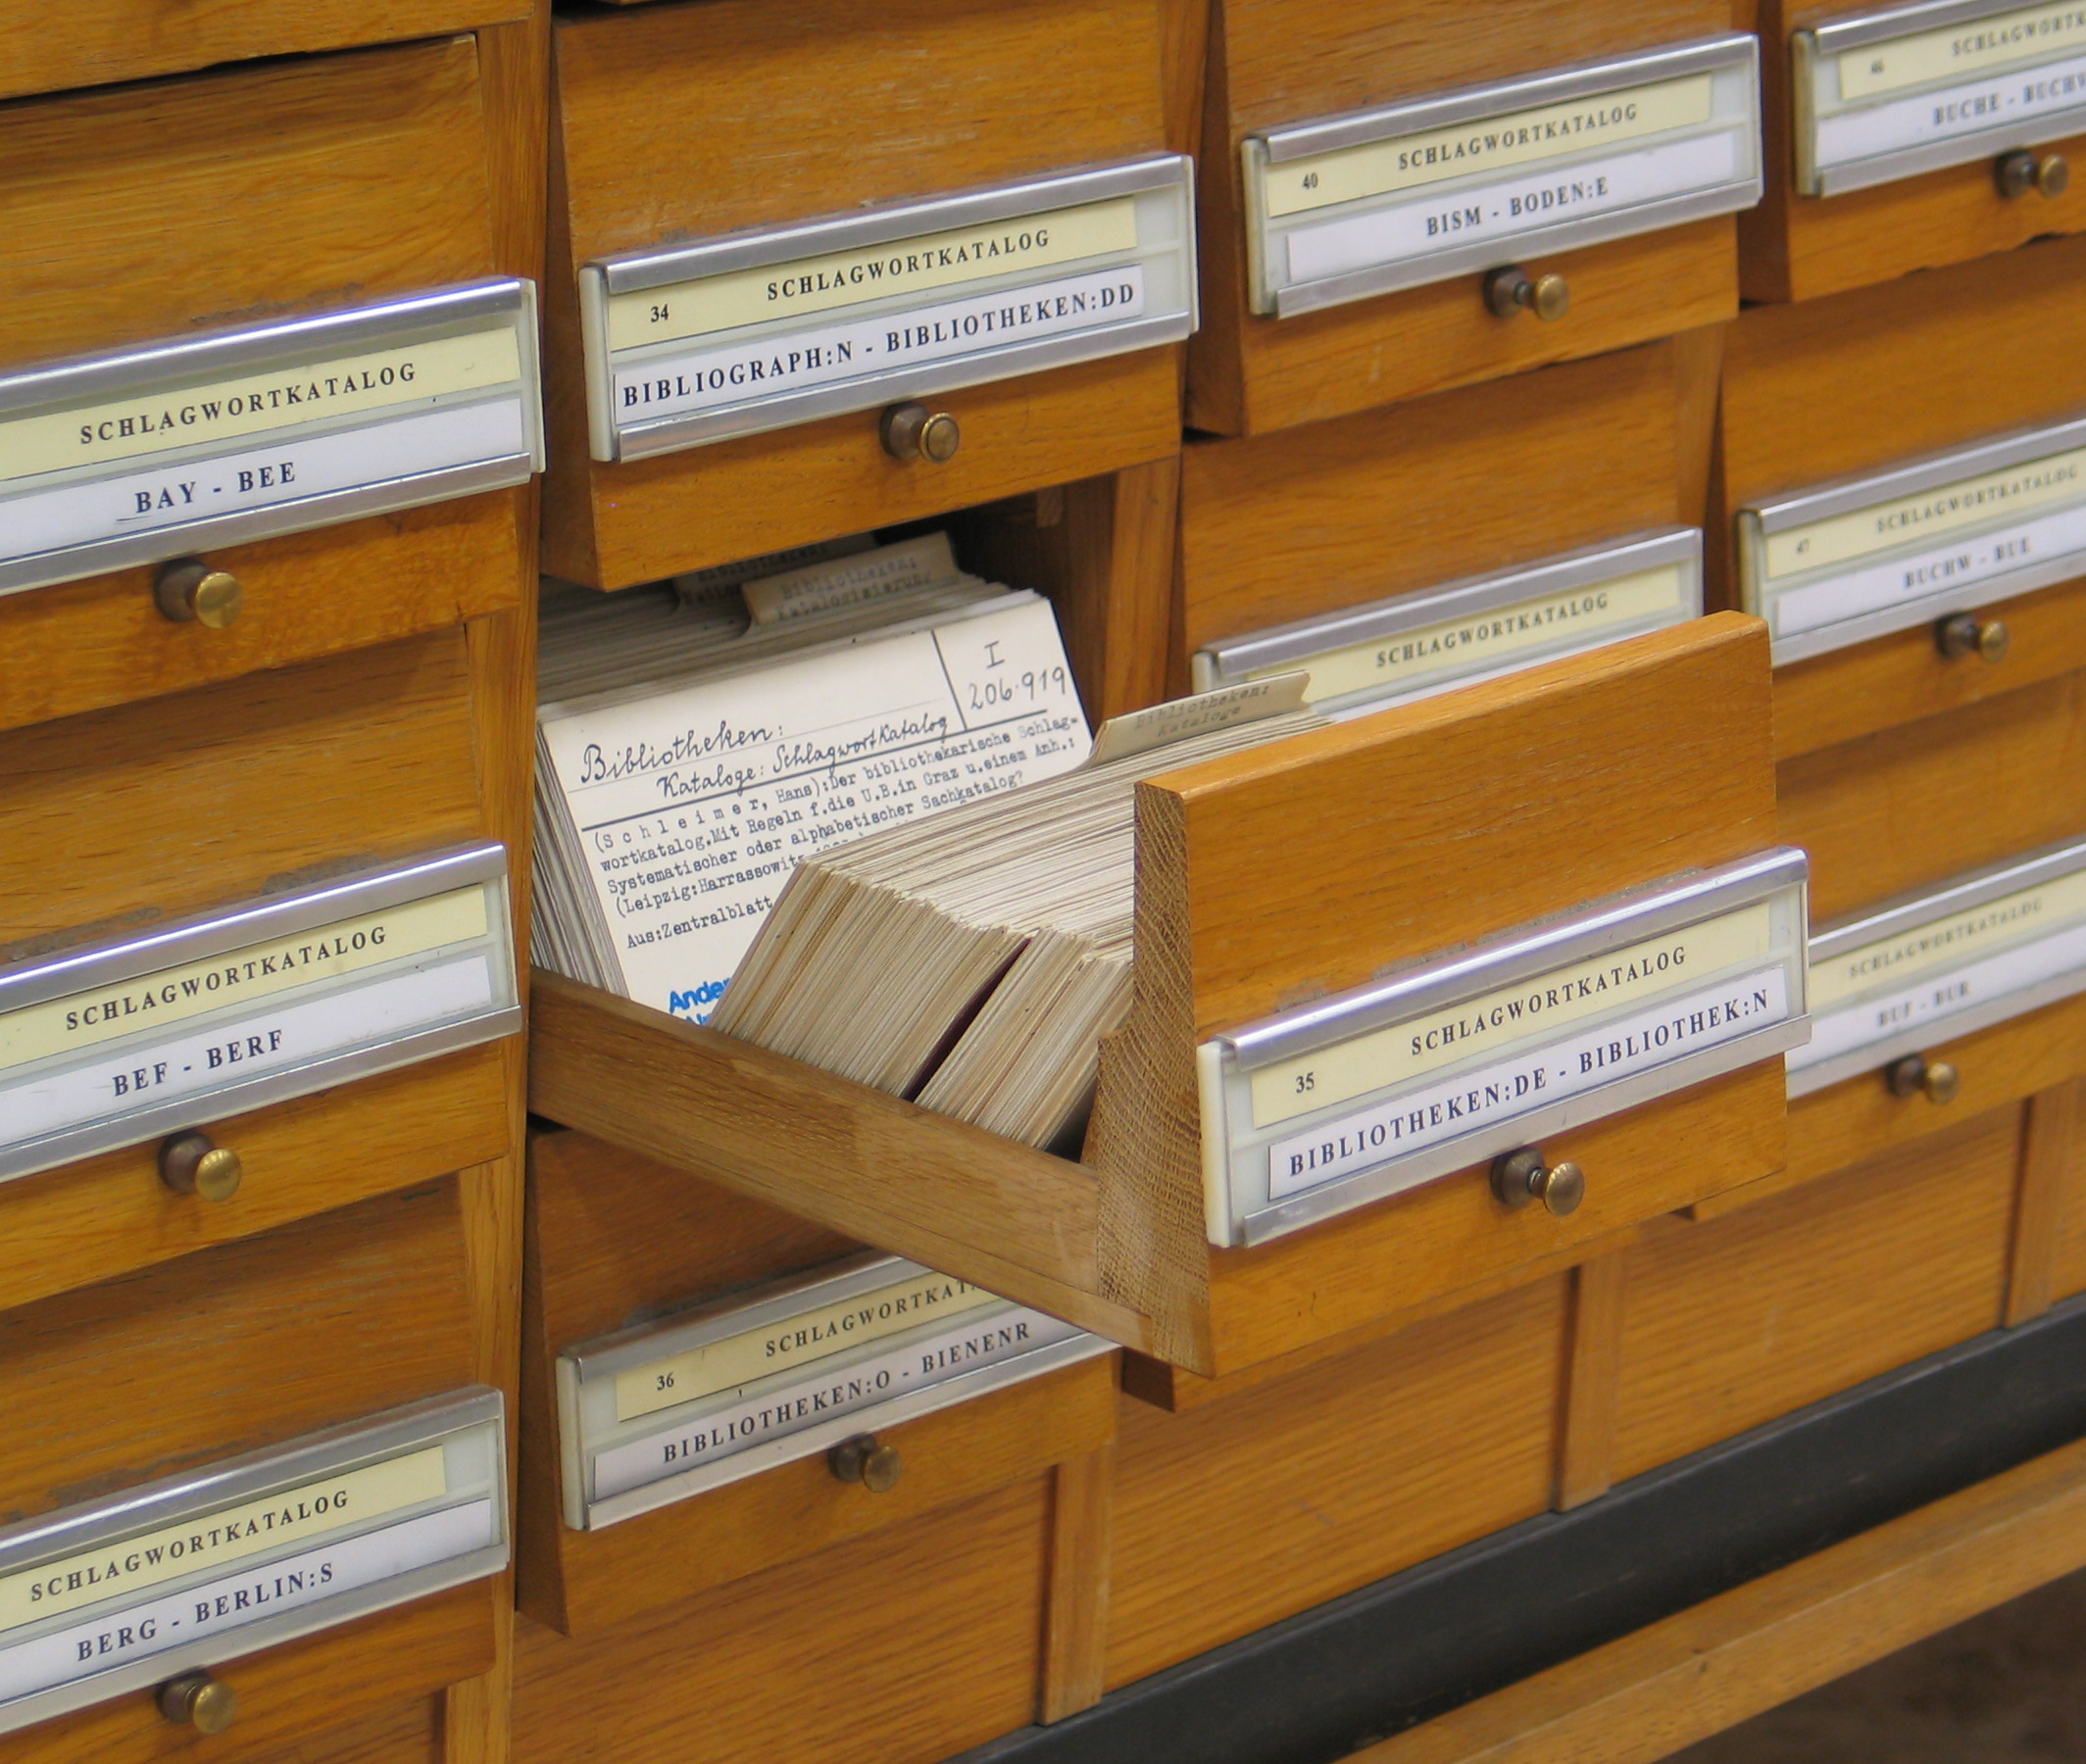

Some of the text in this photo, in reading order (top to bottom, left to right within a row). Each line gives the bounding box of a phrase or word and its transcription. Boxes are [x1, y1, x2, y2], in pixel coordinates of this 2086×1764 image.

[1302, 103, 1638, 190] 40 SCHLAGWORTKATALOG
[1934, 93, 2001, 126] BUCHE
[1426, 206, 1483, 236] BISM
[1511, 176, 1610, 217] BODEN:E
[650, 229, 1051, 324] 34 SCHLAGWORTKATALOG
[622, 341, 854, 408] BIBLIOGRAPH:N
[886, 282, 1135, 354] BIBLIOTHEKEN:DD
[80, 363, 417, 445] SCHLAGWORTKATALOG
[134, 479, 198, 514] BAY
[237, 462, 297, 494] BEE
[1876, 464, 2078, 533] SCHLAGWORTKATALOG
[1375, 593, 1609, 668] SCHLAGWORTKATALOG
[580, 719, 783, 783] Bibliotheken:
[864, 733, 1012, 781] bibliothekarische
[607, 849, 738, 896] Systematischer
[746, 837, 783, 857] oder
[790, 802, 915, 844] alphabetischer
[920, 770, 1024, 810] Sachkatalog?
[746, 808, 804, 836] Regeln
[922, 766, 960, 786] Graz
[626, 895, 773, 950] Aus:Zentralblatt
[1849, 898, 2043, 978] SCHLAGWORTKATALOG
[66, 926, 388, 1031] SCHLAGWORTKATALOG
[1295, 946, 1688, 1095] 35 SCHLAGWORTKATALOG
[112, 1062, 169, 1098] BEF
[207, 1029, 284, 1070] BERF
[1289, 1066, 1548, 1178] BIBLIOTHEKEN:DE
[1578, 989, 1769, 1075] BIBLIOTHEK:N
[656, 1279, 975, 1392] 36 SCHLAGWORTKAT
[663, 1370, 891, 1464] BIBLIOTHEKEN:O
[920, 1322, 1031, 1376] BIENENR
[30, 1490, 351, 1603] SCHLAGWORTKATALOG
[76, 1618, 160, 1662] BERG
[195, 1562, 334, 1624] BERLIN:S
